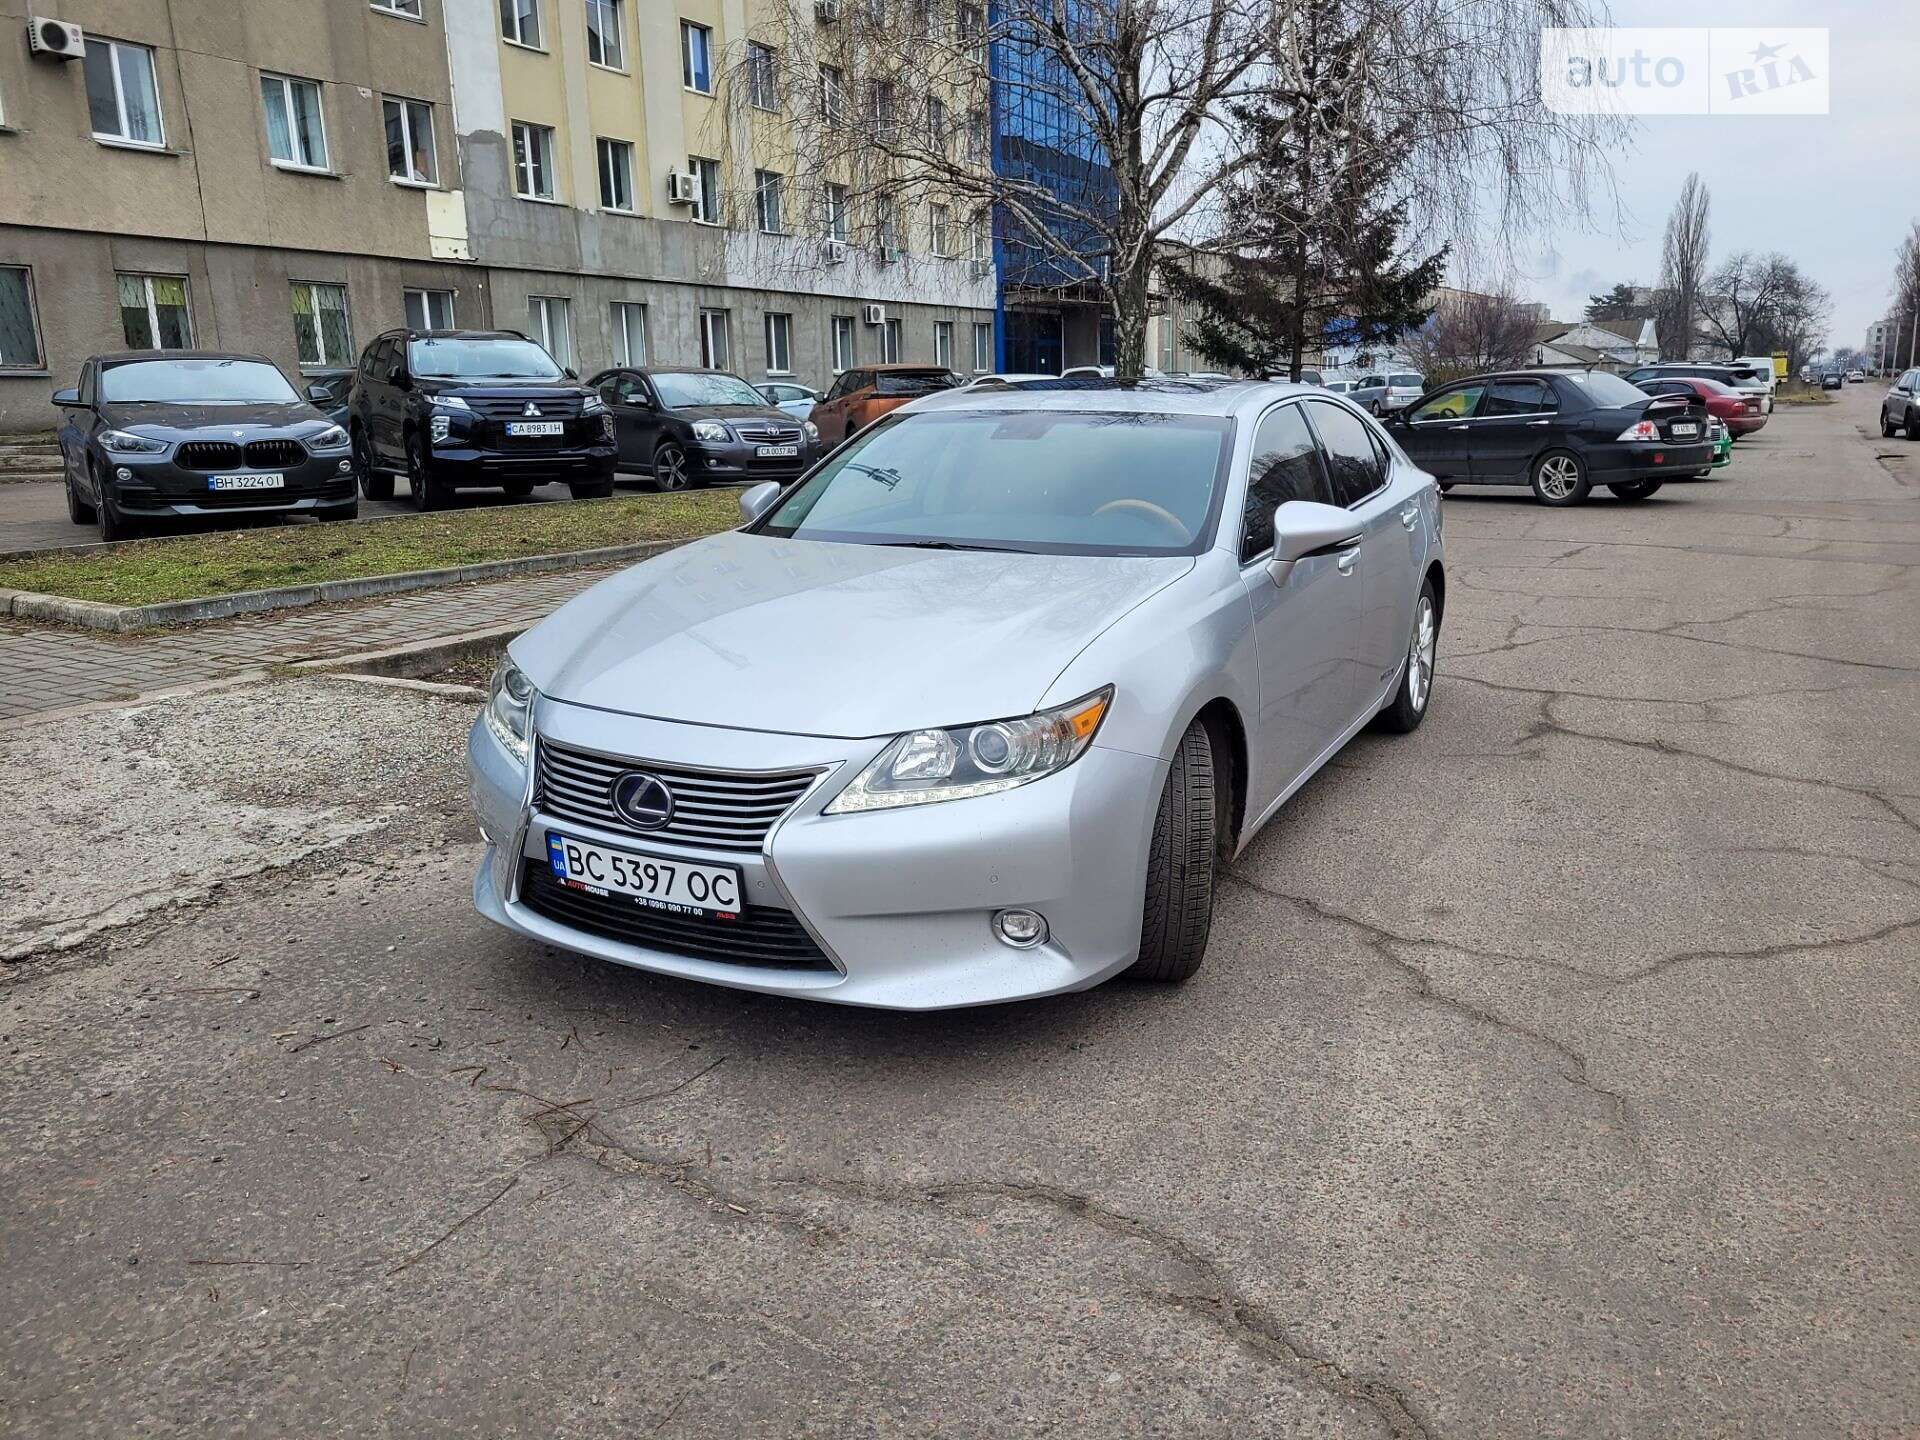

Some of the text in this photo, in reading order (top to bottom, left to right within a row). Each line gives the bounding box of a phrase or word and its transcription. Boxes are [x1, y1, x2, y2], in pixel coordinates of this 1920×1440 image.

[511, 424, 525, 433] CA
[526, 424, 547, 433] 8983
[215, 478, 234, 488] BH
[236, 477, 264, 488] 3224
[553, 860, 566, 871] UA
[566, 844, 735, 905] BC 5397 OC
[683, 905, 692, 914] 77
[693, 907, 703, 916] 00
